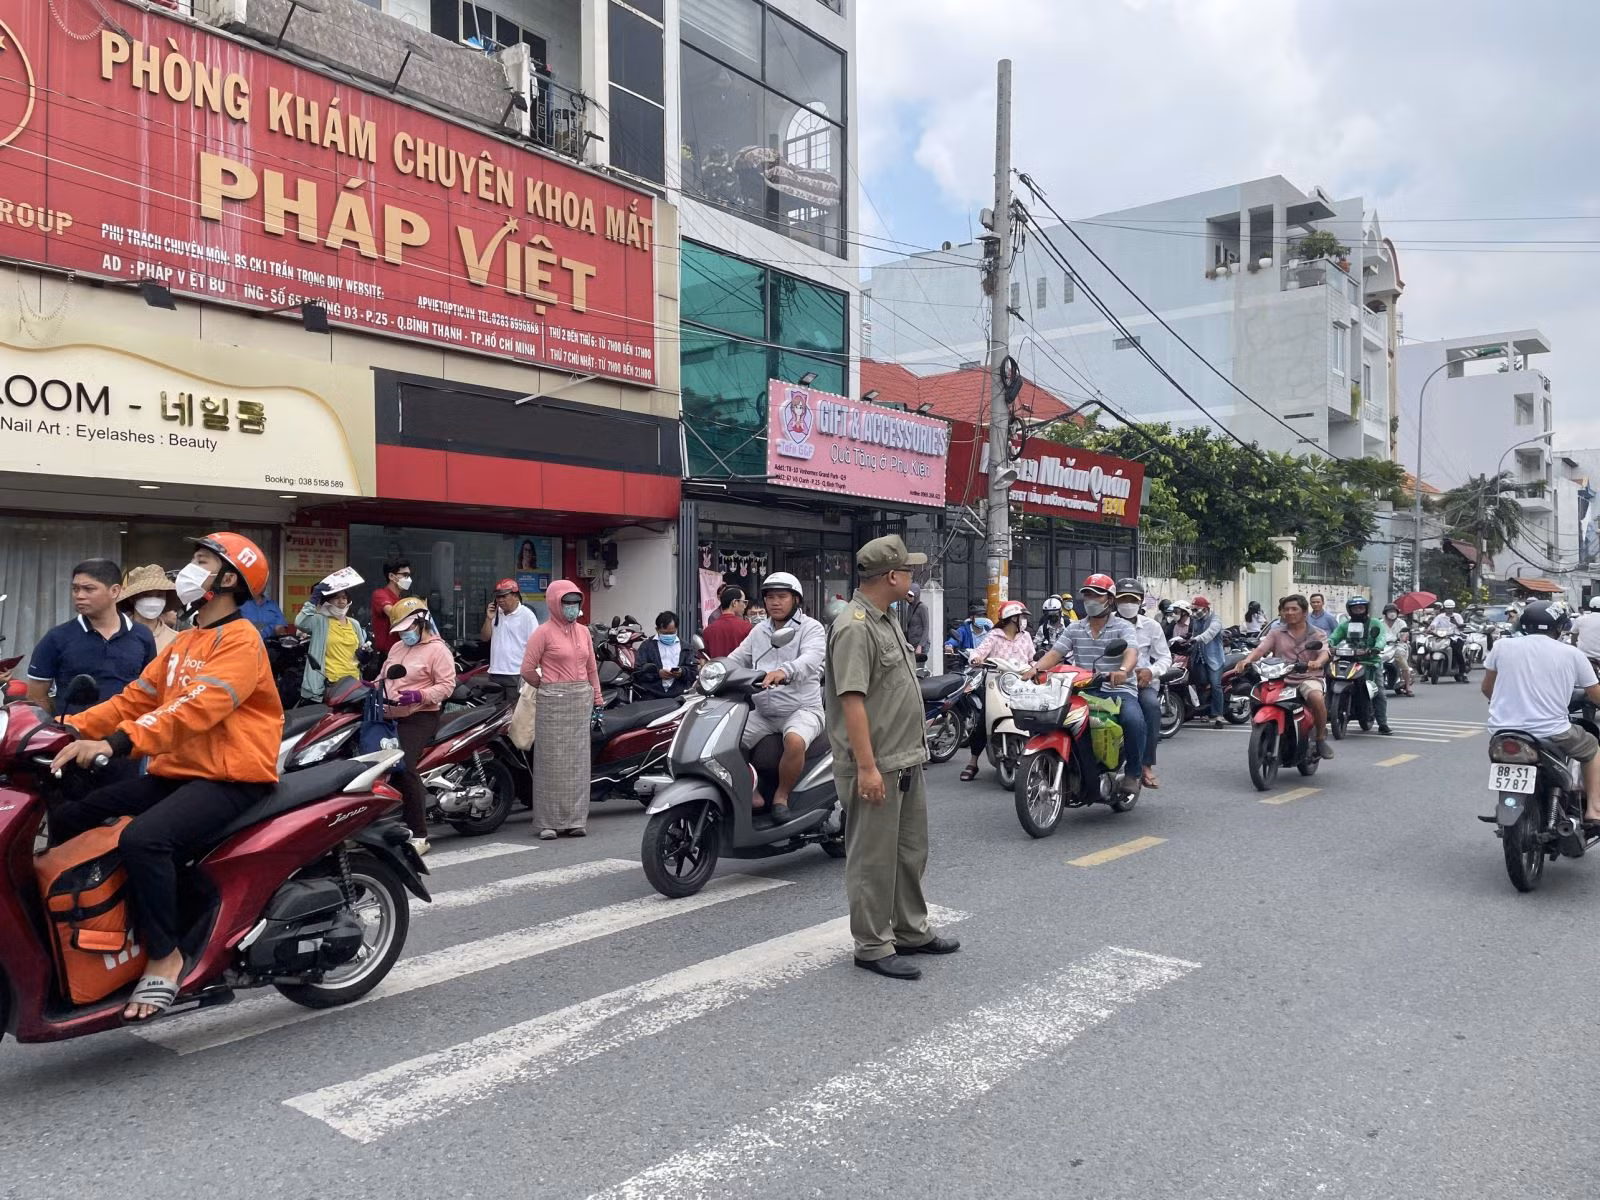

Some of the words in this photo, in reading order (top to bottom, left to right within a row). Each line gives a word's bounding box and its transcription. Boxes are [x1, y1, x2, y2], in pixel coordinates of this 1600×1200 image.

[101, 29, 250, 123] PHÒNG
[269, 87, 377, 163] KHÁM
[393, 132, 514, 208] CHUYÊN
[526, 176, 597, 235] KHOA
[605, 198, 653, 251] MẮT
[200, 151, 431, 265] PHÁP
[457, 215, 596, 315] VIỆT
[102, 223, 124, 245] PHỤ
[126, 228, 162, 250] TRÁCH
[164, 237, 204, 259] CHUYÊN
[206, 246, 230, 266] MÔN:
[297, 268, 325, 287] TRỌNG
[327, 275, 343, 290] DUY
[346, 279, 385, 300] WEBSITE:
[344, 306, 358, 320] D3
[397, 315, 429, 334] Q.BÌNH
[432, 323, 462, 341] THẠNH
[470, 330, 497, 348] TP.HỒ
[499, 337, 514, 352] CHÍ
[515, 341, 535, 356] MINH
[549, 326, 562, 340] THỨ
[562, 329, 566, 341] 2
[579, 332, 591, 346] THỨ
[549, 347, 562, 361] THỨ
[563, 352, 567, 363] 7
[568, 349, 580, 365] CHỦ
[0, 373, 110, 416] OOM
[0, 416, 32, 434] Nail
[37, 421, 61, 436] Art
[76, 424, 155, 445] Eyelashes
[169, 433, 218, 452] Beauty
[819, 399, 849, 438] GIFT
[851, 408, 860, 440] &
[863, 411, 947, 456] ACCESSORIES
[831, 443, 851, 466] Quà
[853, 447, 877, 472] Tặng
[890, 456, 909, 478] Phụ
[911, 460, 930, 480] Kiện
[264, 474, 297, 487] Booking:
[298, 477, 313, 486] 038
[313, 478, 330, 487] 5158
[330, 479, 344, 488] 589
[1495, 778, 1528, 791] 5787
[1497, 766, 1529, 779] 88-S1
